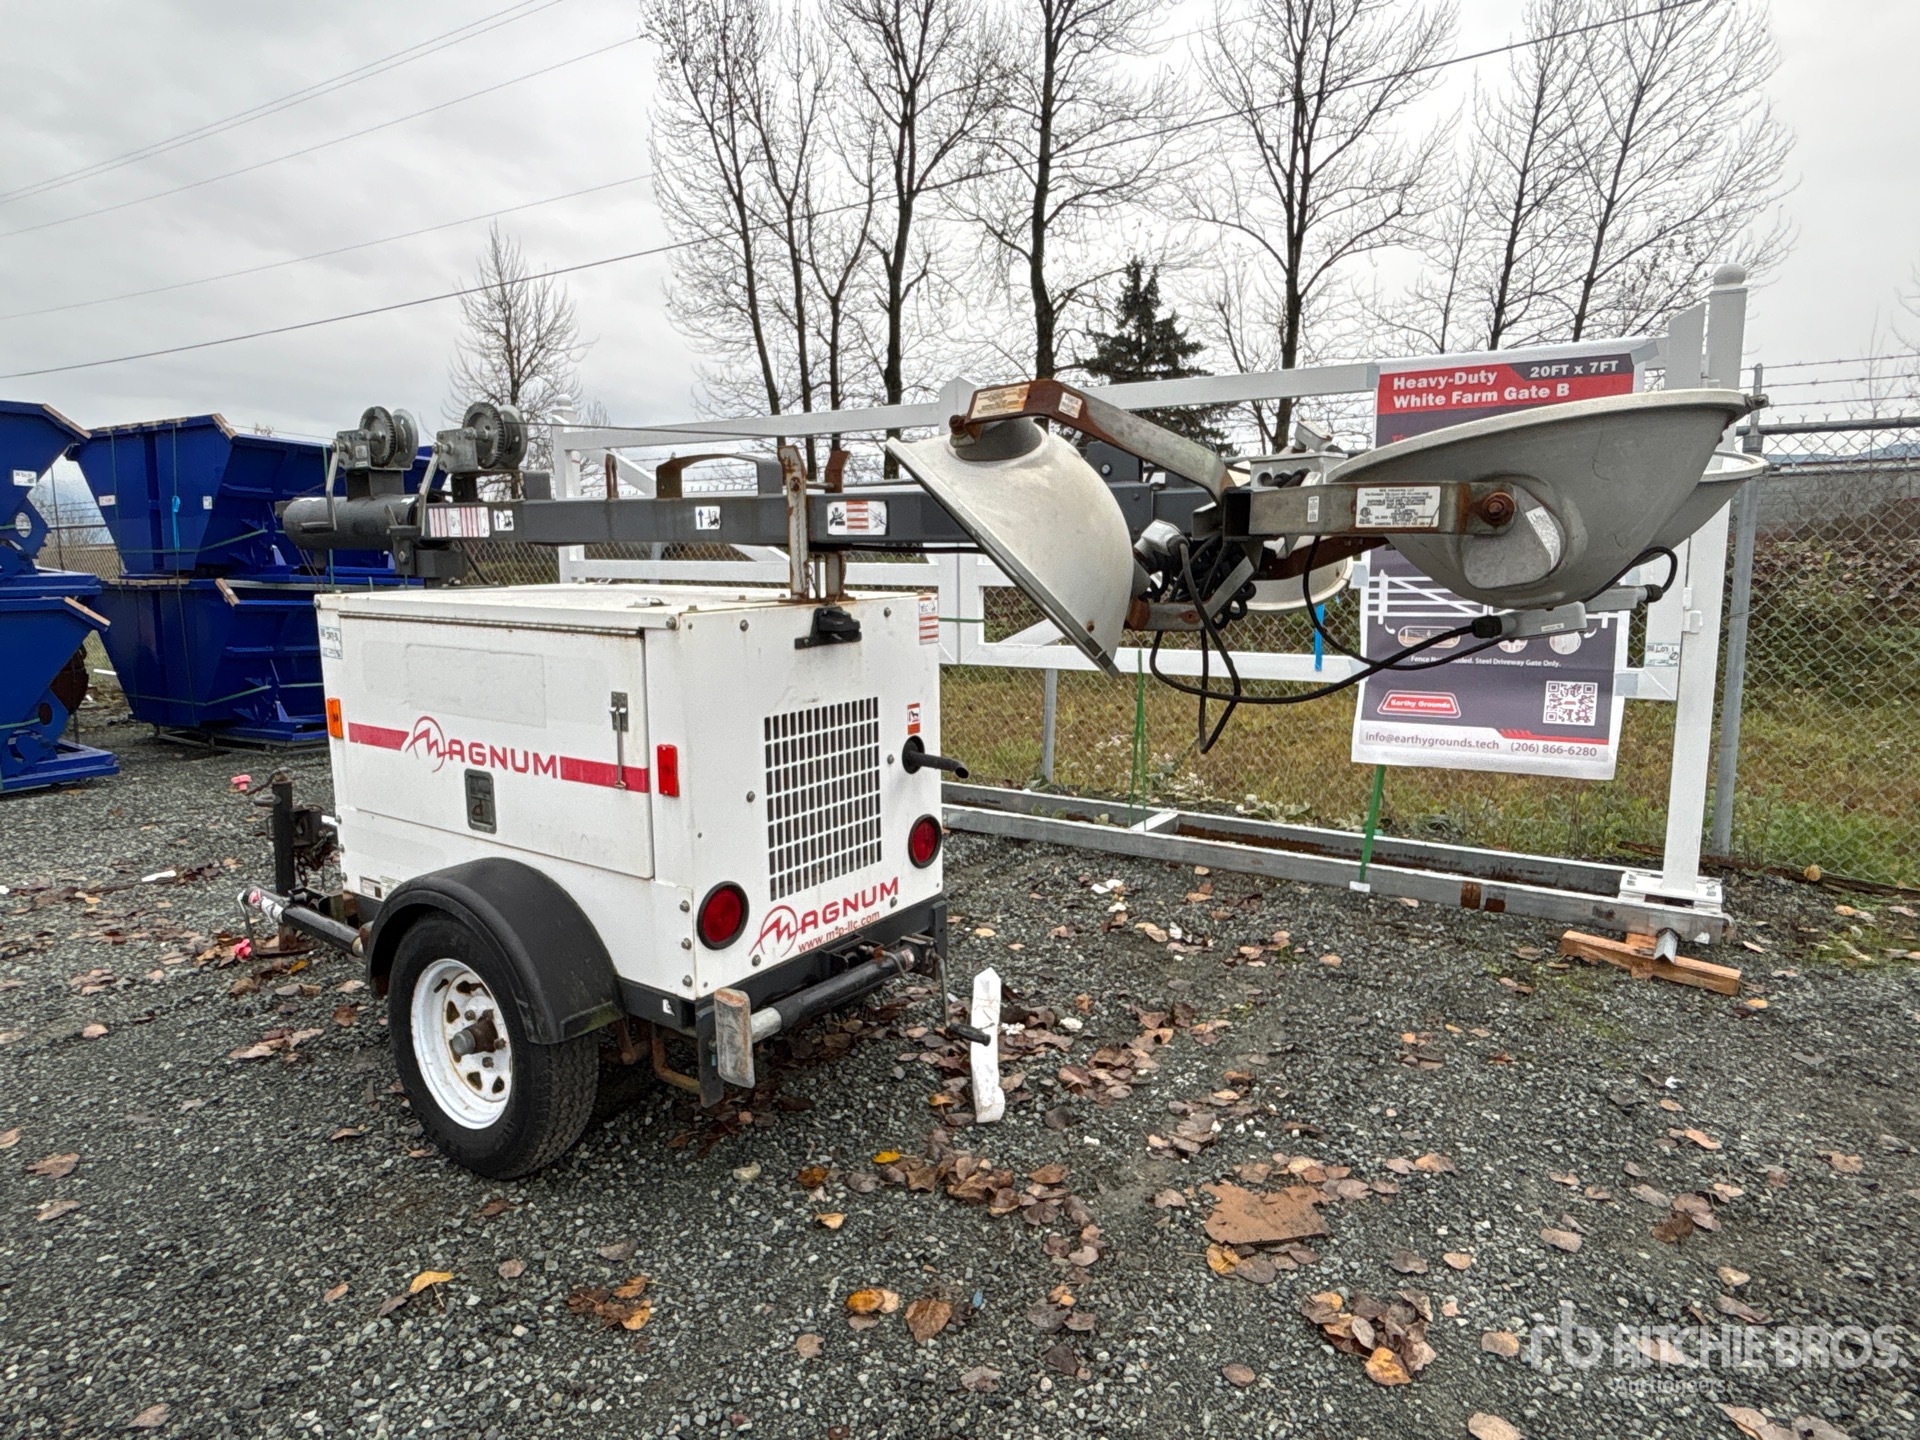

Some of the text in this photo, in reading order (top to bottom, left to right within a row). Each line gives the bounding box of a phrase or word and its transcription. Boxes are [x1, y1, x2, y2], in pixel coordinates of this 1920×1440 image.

[1393, 371, 1498, 390] Heavy-Duty
[1530, 361, 1619, 378] 20FT x 7FT
[1393, 383, 1570, 409] White Farm Gate B
[1475, 657, 1492, 665] Steel
[1493, 658, 1524, 667] Driveway
[1525, 659, 1542, 667] Gate
[1543, 660, 1562, 668] Only.
[1390, 699, 1451, 709] Earthy Grounds
[405, 716, 557, 778] MAGNUM
[1366, 732, 1597, 757] info@earthygrounds.tech (206) 866-6280
[749, 877, 899, 956] MAGNUM
